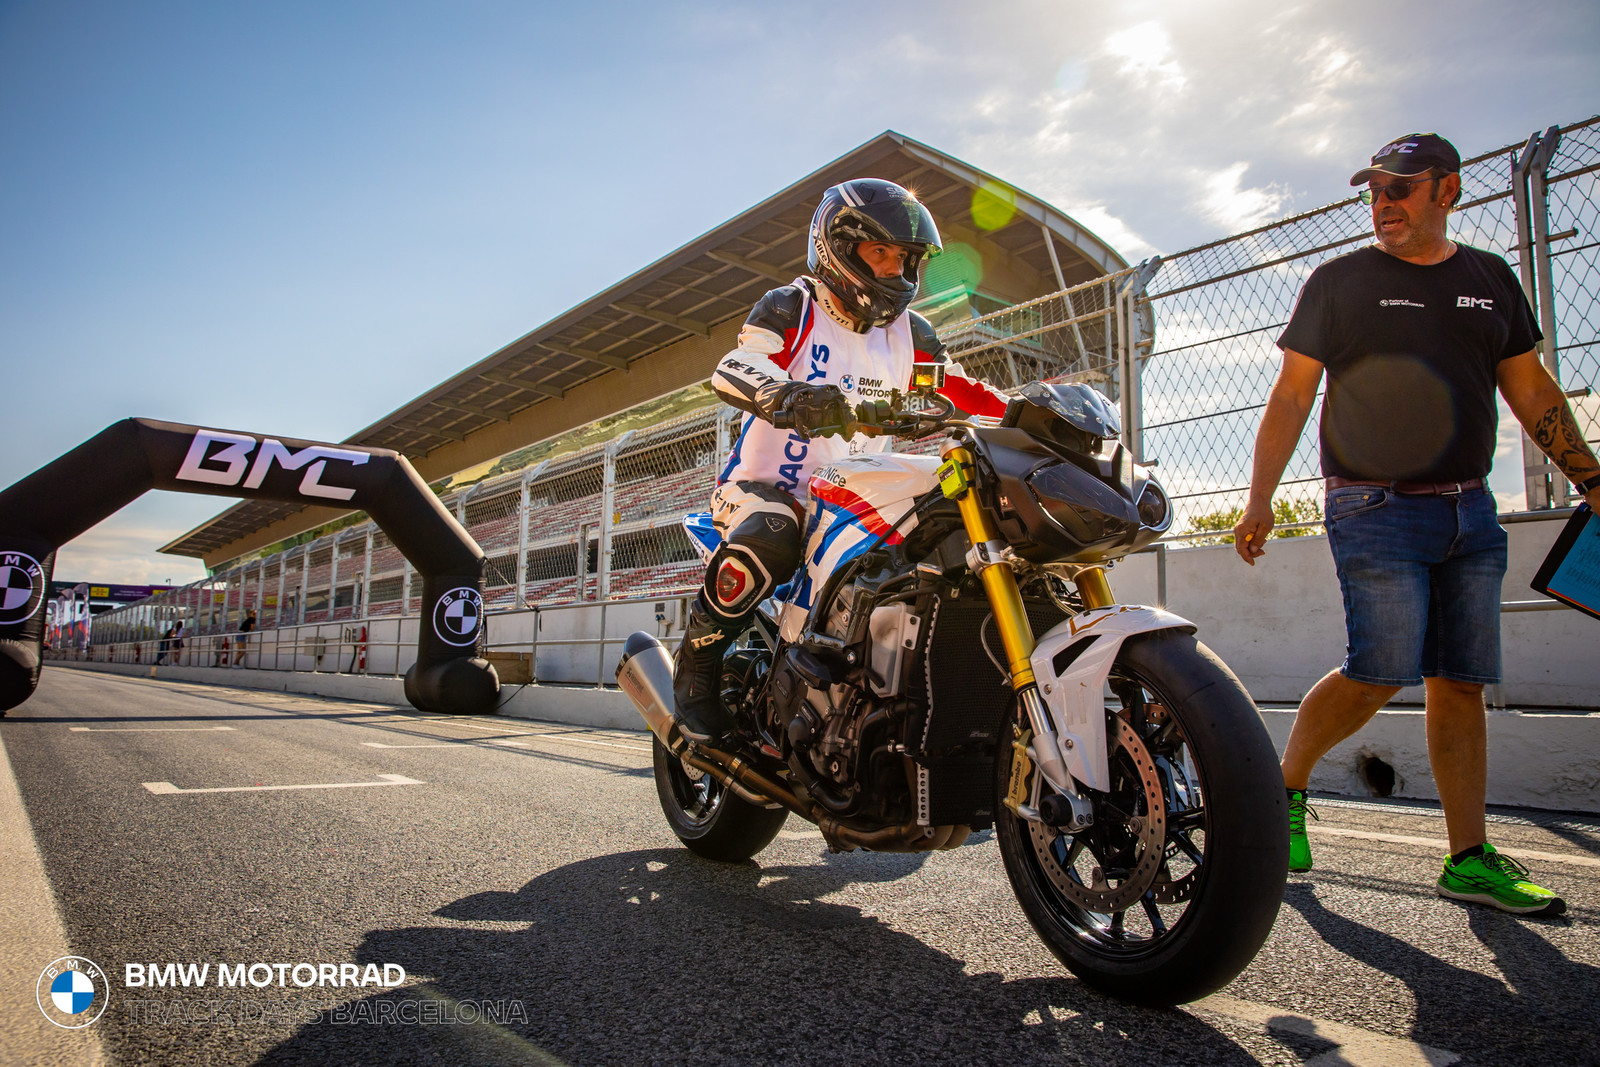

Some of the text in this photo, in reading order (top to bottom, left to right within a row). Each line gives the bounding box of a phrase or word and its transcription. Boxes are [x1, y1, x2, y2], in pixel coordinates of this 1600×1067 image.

[1375, 142, 1418, 160] BMC
[1456, 296, 1493, 310] BMC
[806, 344, 830, 382] YS
[858, 377, 882, 388] BMW
[857, 387, 893, 399] MOTOR
[176, 429, 371, 501] BMC
[775, 428, 811, 492] RACK
[442, 590, 481, 606] BMW
[1011, 761, 1022, 795] brembo
